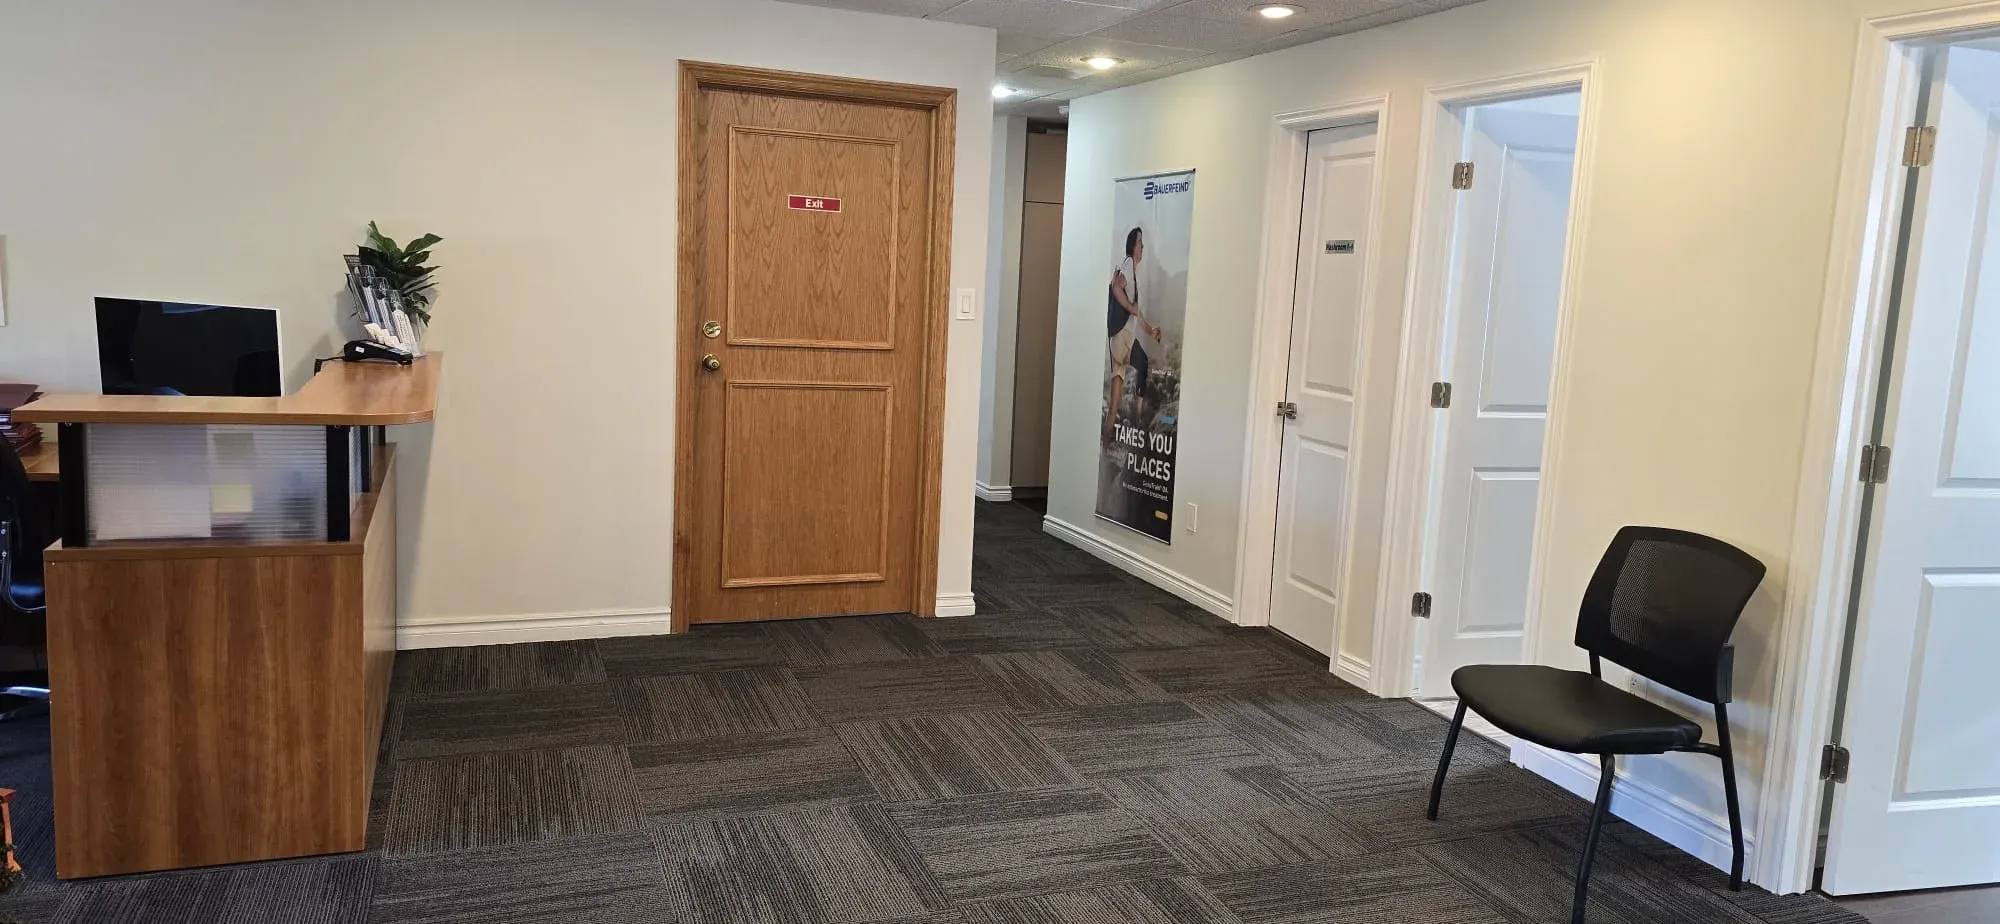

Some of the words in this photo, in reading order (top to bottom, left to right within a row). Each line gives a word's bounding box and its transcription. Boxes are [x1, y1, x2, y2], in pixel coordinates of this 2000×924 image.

[1153, 181, 1189, 195] BAUERFEIND
[805, 198, 824, 209] Exit
[1114, 423, 1145, 449] TAKES
[1149, 431, 1173, 455] YOU
[1127, 452, 1171, 482] PLACES
